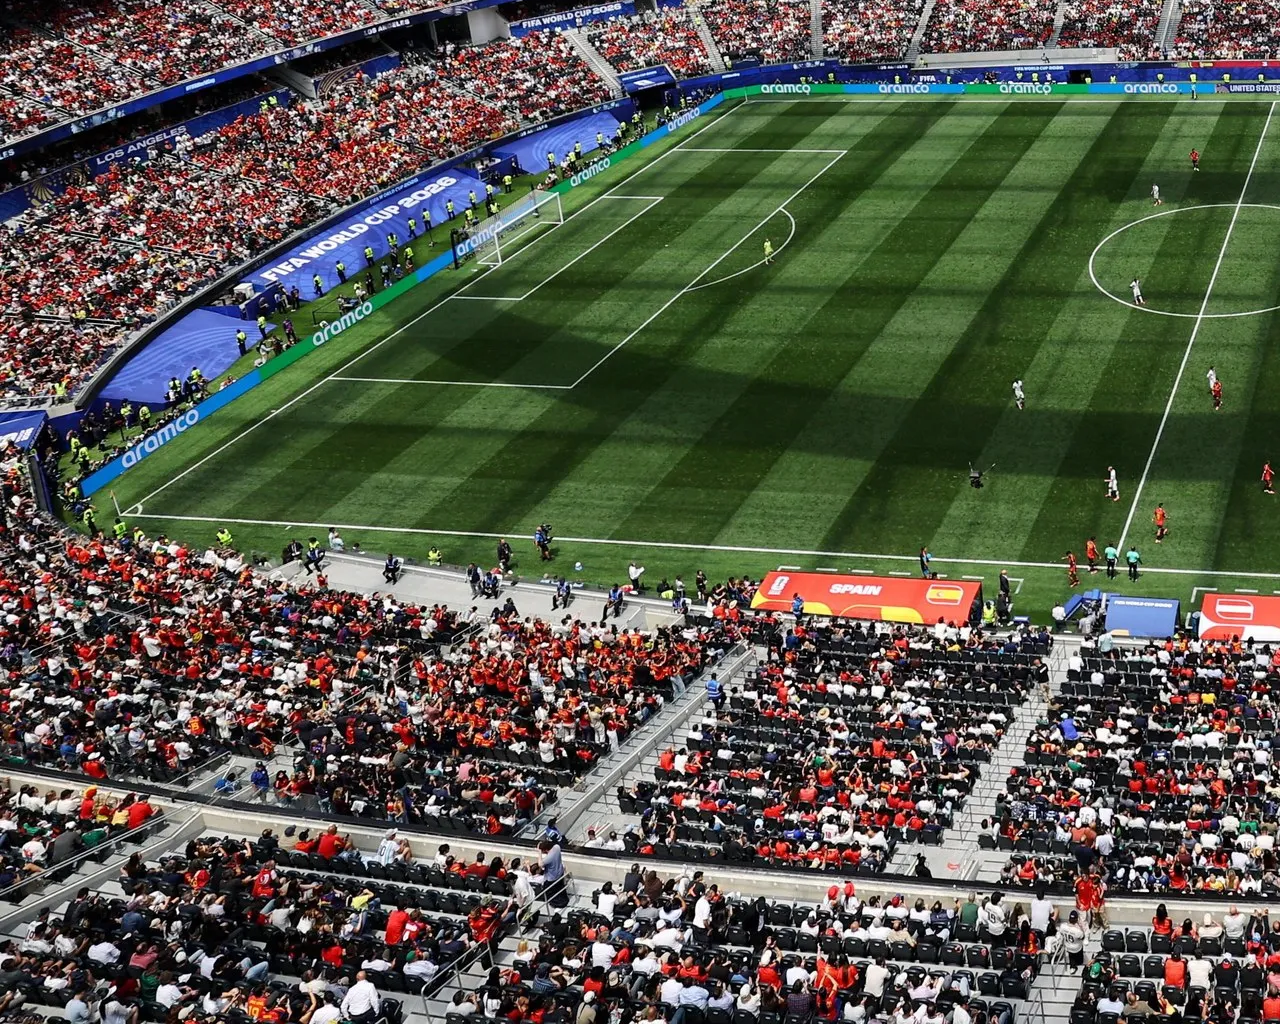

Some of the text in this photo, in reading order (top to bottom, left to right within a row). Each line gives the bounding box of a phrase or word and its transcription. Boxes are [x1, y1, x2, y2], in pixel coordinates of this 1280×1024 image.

[522, 3, 621, 29] FIFA WORLD CUP 2026
[760, 83, 811, 93] aramco
[879, 83, 929, 93] aramco
[920, 74, 936, 82] FIFA
[1000, 83, 1052, 94] aramco
[1124, 83, 1177, 93] aramco
[667, 107, 700, 132] aramco
[96, 125, 187, 164] LOS ANGELES
[570, 158, 610, 188] aramco
[260, 176, 457, 283] FIFA WORLD CUP 2026
[456, 221, 503, 256] aramco
[312, 301, 373, 346] aramco
[121, 409, 199, 468] aramco
[829, 583, 883, 596] SPAIN
